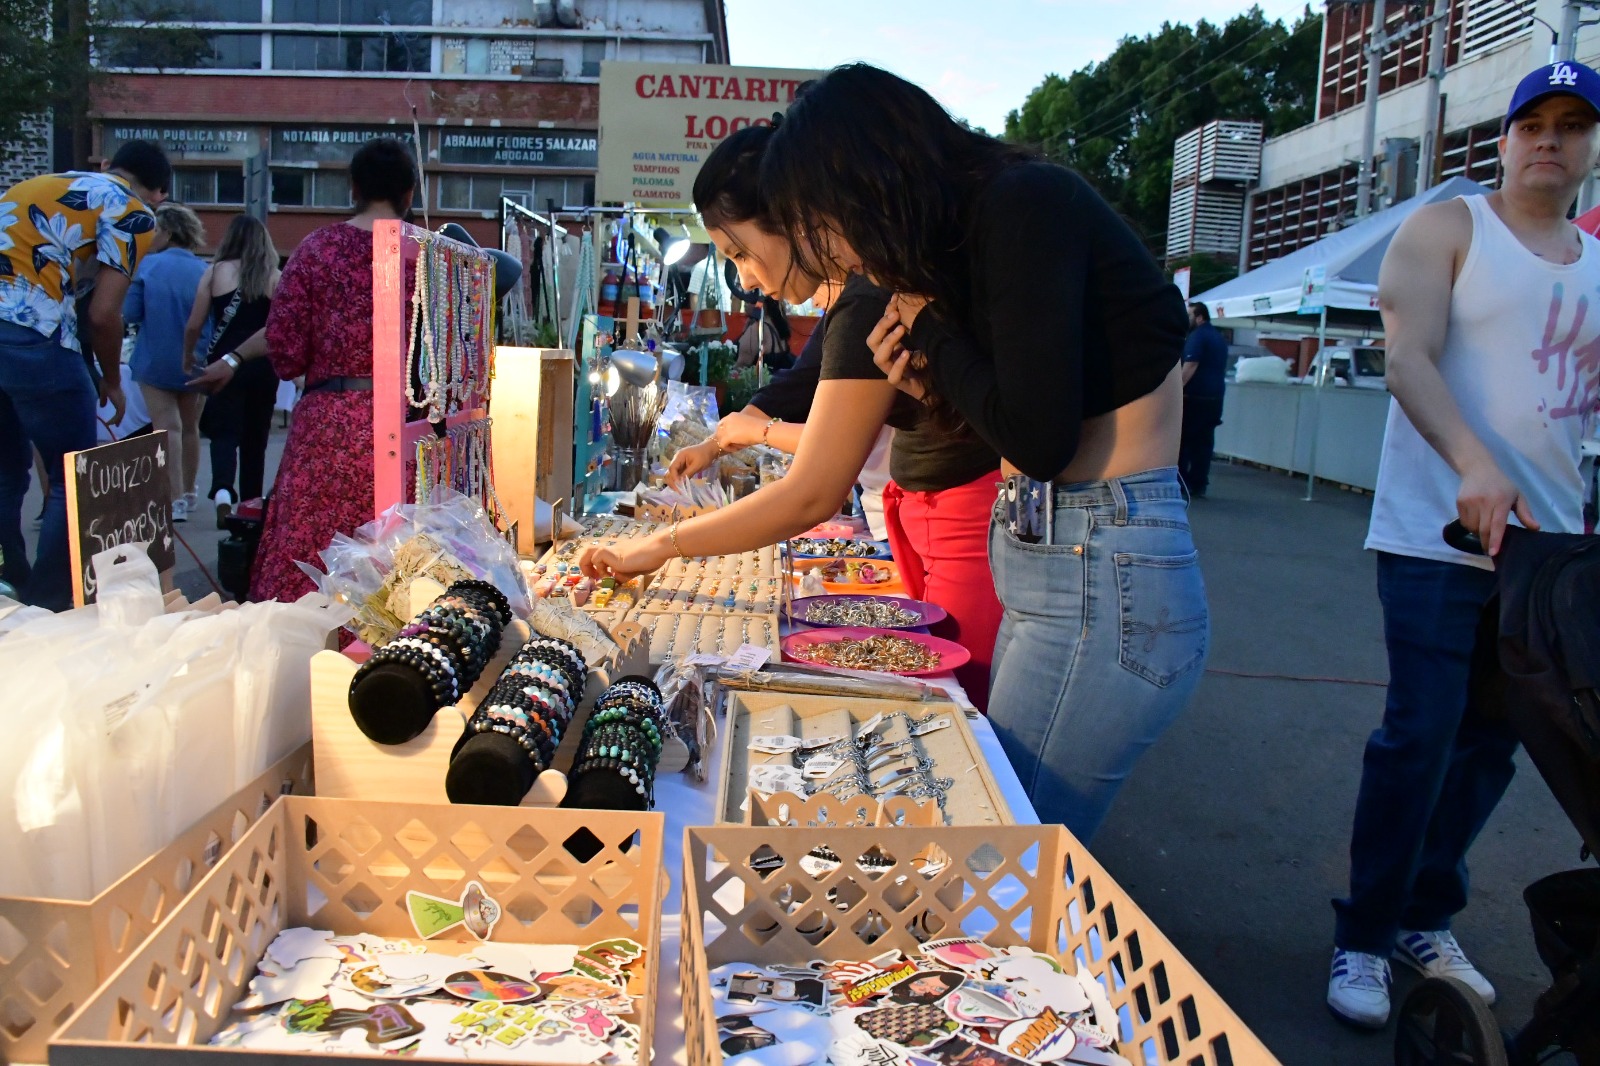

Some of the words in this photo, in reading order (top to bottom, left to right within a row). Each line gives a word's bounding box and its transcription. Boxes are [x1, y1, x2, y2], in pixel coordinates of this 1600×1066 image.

[1548, 62, 1578, 86] LA
[635, 74, 801, 103] CANTARIT
[115, 128, 159, 141] NOTARIA
[163, 129, 214, 142] PUBLICA
[283, 131, 330, 143] NOTARIA
[445, 135, 494, 148] ABRAHAM
[496, 136, 543, 150] FLORES
[546, 137, 597, 151] SALAZAR
[494, 150, 544, 161] ABOGADO
[632, 152, 656, 161] AGUA
[659, 152, 699, 163] NATURAL
[633, 164, 680, 175] VAMPIROS
[632, 176, 675, 187] PALOMAS
[632, 189, 681, 200] CLAMATOS
